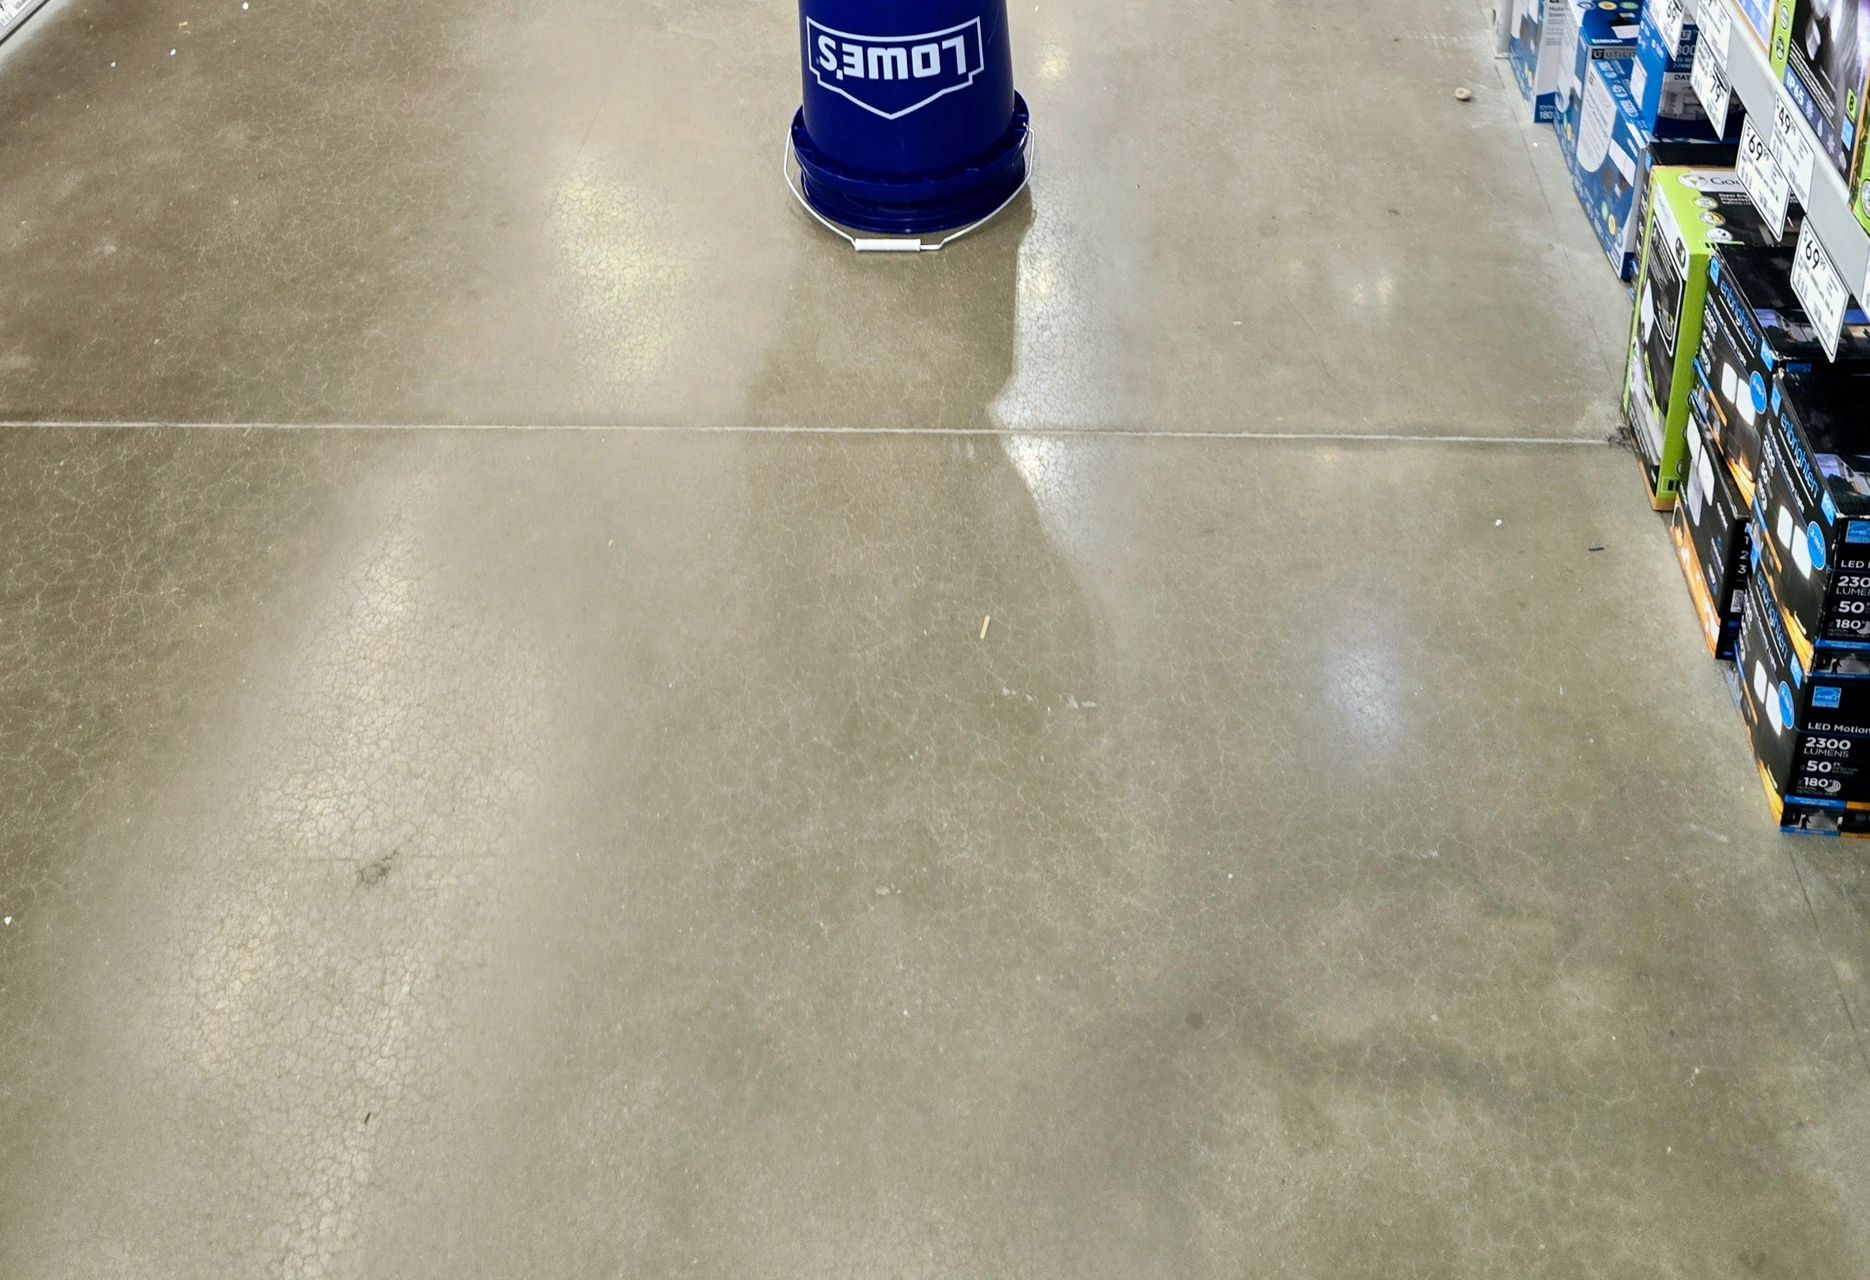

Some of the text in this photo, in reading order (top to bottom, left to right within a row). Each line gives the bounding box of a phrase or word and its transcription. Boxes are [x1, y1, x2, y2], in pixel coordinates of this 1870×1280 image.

[816, 34, 967, 81] LOWE'S
[1786, 73, 1804, 105] IP65
[1720, 280, 1758, 351] enbrighten
[1780, 412, 1820, 498] enbrighten
[1840, 559, 1865, 569] LED
[1838, 600, 1865, 614] 50
[1757, 572, 1788, 660] enbrighten
[1807, 721, 1831, 731] LED
[1804, 736, 1852, 751] 2300
[1803, 747, 1850, 759] LUMENS
[1806, 760, 1832, 773] 50
